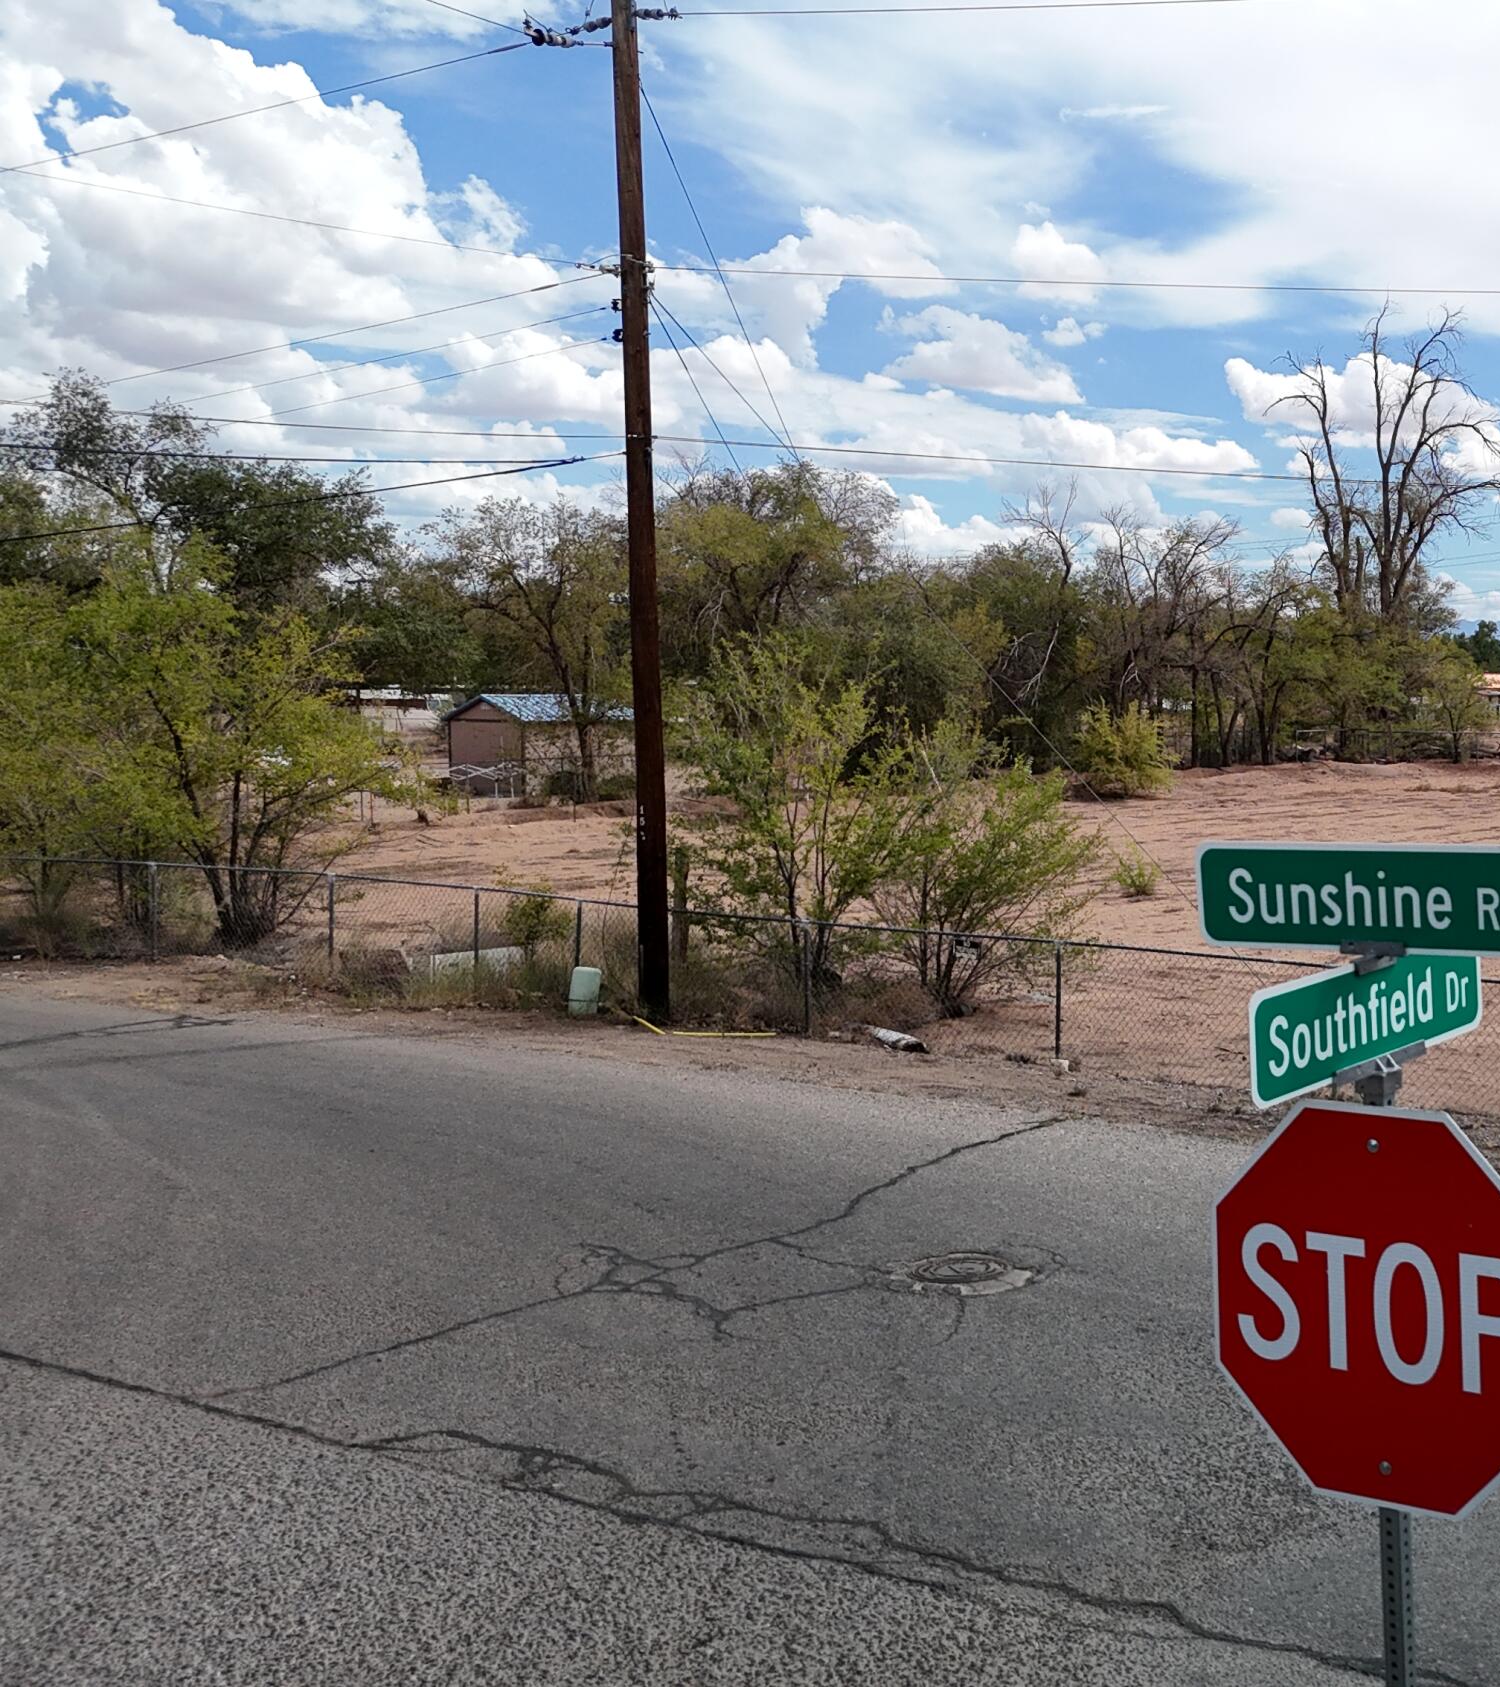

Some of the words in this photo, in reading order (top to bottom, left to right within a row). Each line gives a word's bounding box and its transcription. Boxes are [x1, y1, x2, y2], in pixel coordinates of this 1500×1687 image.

[1228, 867, 1453, 930] Sunshine
[1268, 966, 1434, 1078] Southfield
[1445, 971, 1469, 1013] Dr
